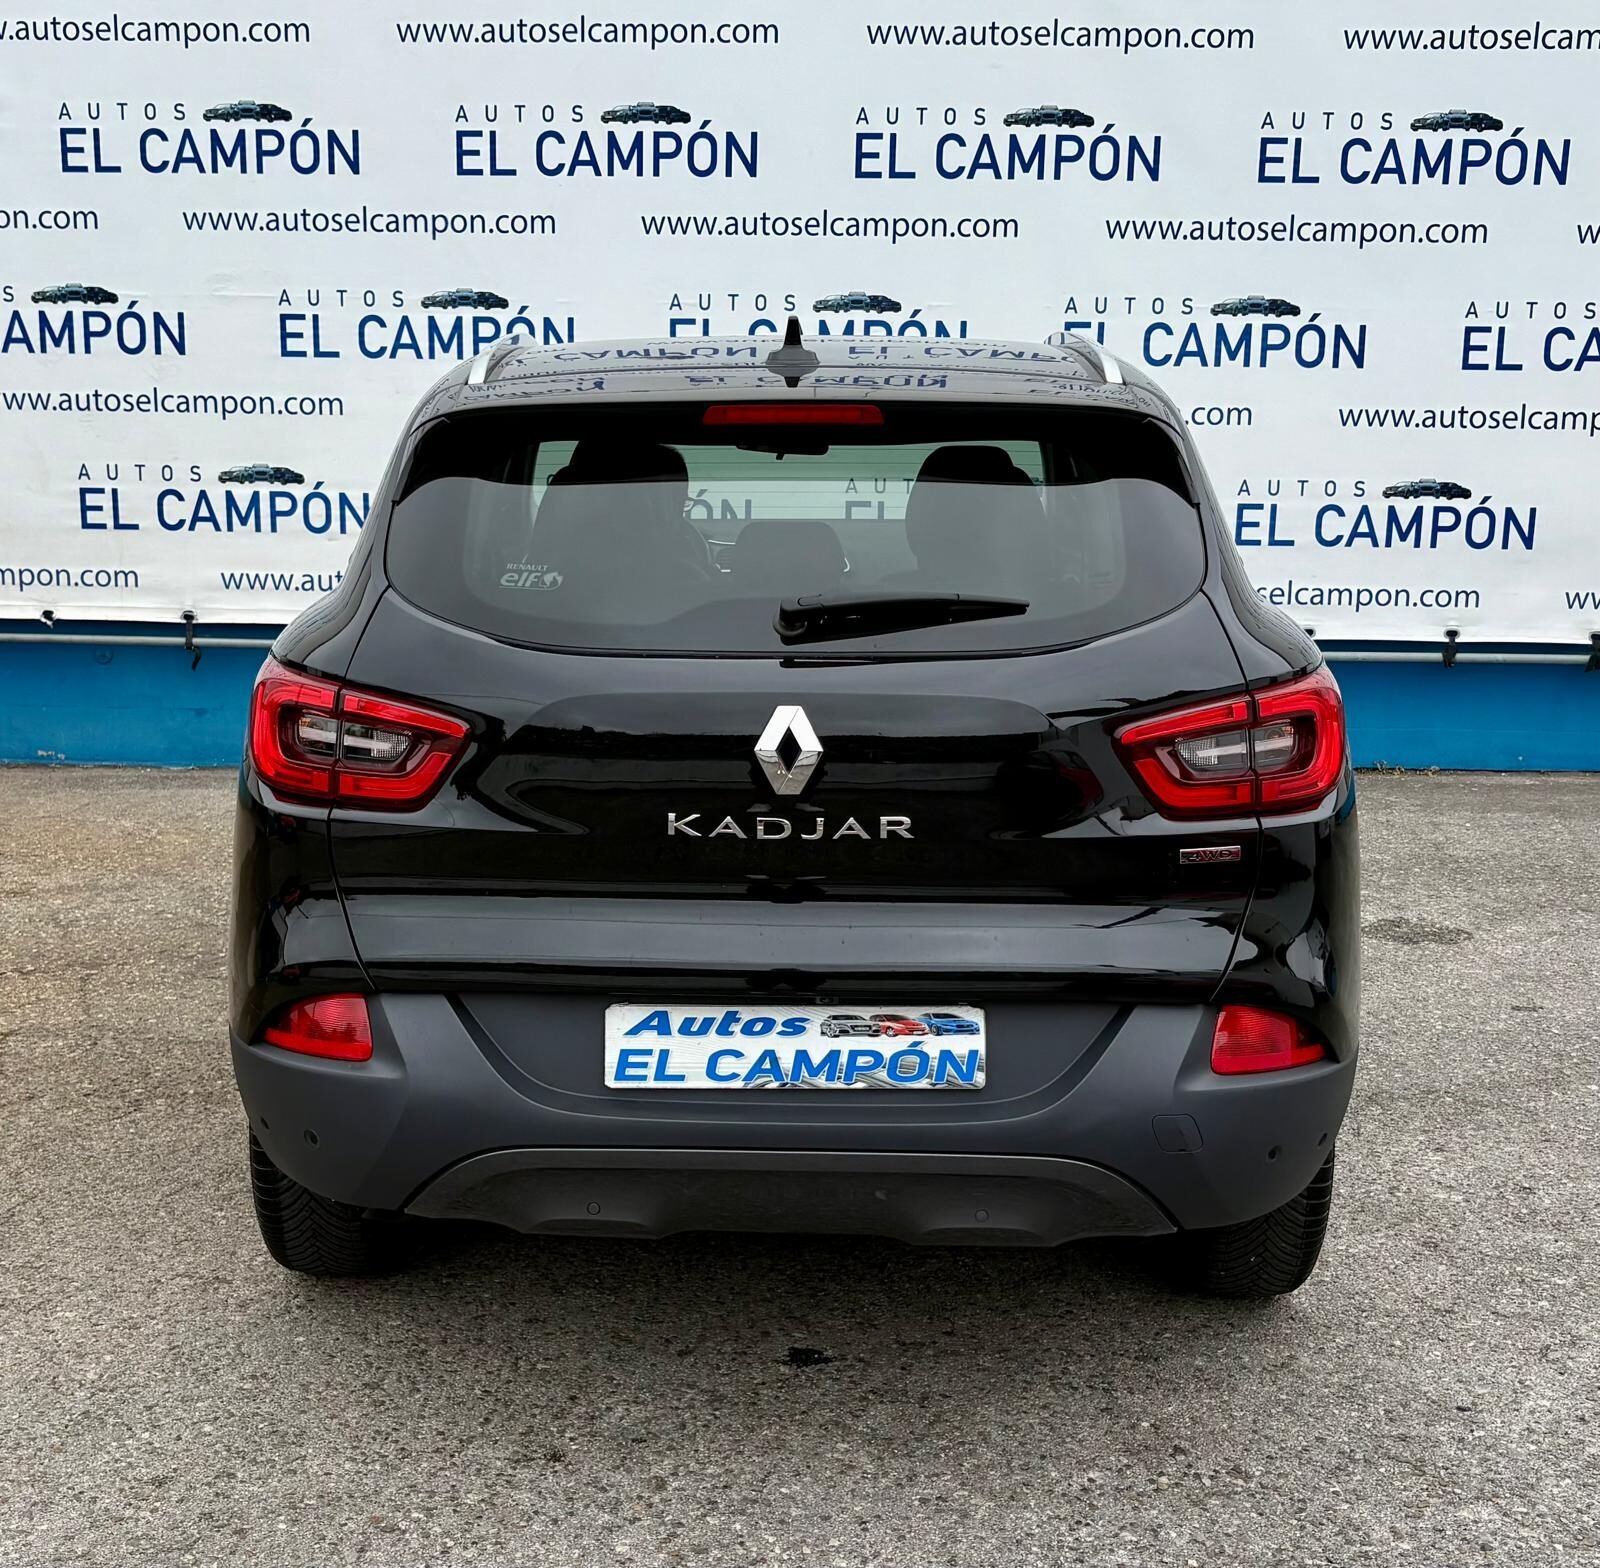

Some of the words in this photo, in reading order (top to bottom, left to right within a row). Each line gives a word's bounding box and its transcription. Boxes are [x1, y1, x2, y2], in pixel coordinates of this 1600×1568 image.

[397, 15, 778, 50] www.autoselcampon.com
[867, 19, 1253, 54] www.autoselcampon.com
[59, 103, 185, 120] AUTOS
[456, 105, 583, 122] AUTOS
[856, 107, 985, 125] AUTOS
[1261, 112, 1392, 130] AUTOS
[60, 128, 121, 173] EL
[140, 118, 359, 175] CAMPÓN
[456, 130, 516, 176] EL
[536, 120, 757, 177] CAMPÓN
[855, 133, 915, 178] EL
[936, 124, 1161, 181] CAMPÓN
[1258, 137, 1319, 183] EL
[1341, 127, 1570, 185] CAMPÓN
[183, 206, 555, 240] www.autoselcampon.com
[642, 210, 1018, 244] www.autoselcampon.com
[1106, 215, 1487, 249] www.autoselcampon.com
[279, 289, 403, 307] AUTOS
[670, 294, 795, 311] AUTOS
[1065, 297, 1192, 314] AUTOS
[1465, 302, 1595, 319] AUTOS
[280, 314, 340, 358] EL
[358, 305, 575, 360] CAMPÓN
[1144, 313, 1366, 368] CAMPÓN
[1462, 326, 1522, 370] EL
[79, 464, 201, 482] AUTOS
[1238, 480, 1365, 497] AUTOS
[79, 488, 139, 530] EL
[156, 480, 369, 535] CAMPÓN
[1235, 503, 1295, 546] EL
[1315, 496, 1536, 550] CAMPÓN
[500, 571, 542, 588] elf
[507, 562, 548, 571] RENAULT
[667, 812, 915, 840] KADJAR
[623, 1010, 812, 1037] Autos
[613, 1048, 687, 1082] EL
[704, 1041, 980, 1083] CAMPÓN
